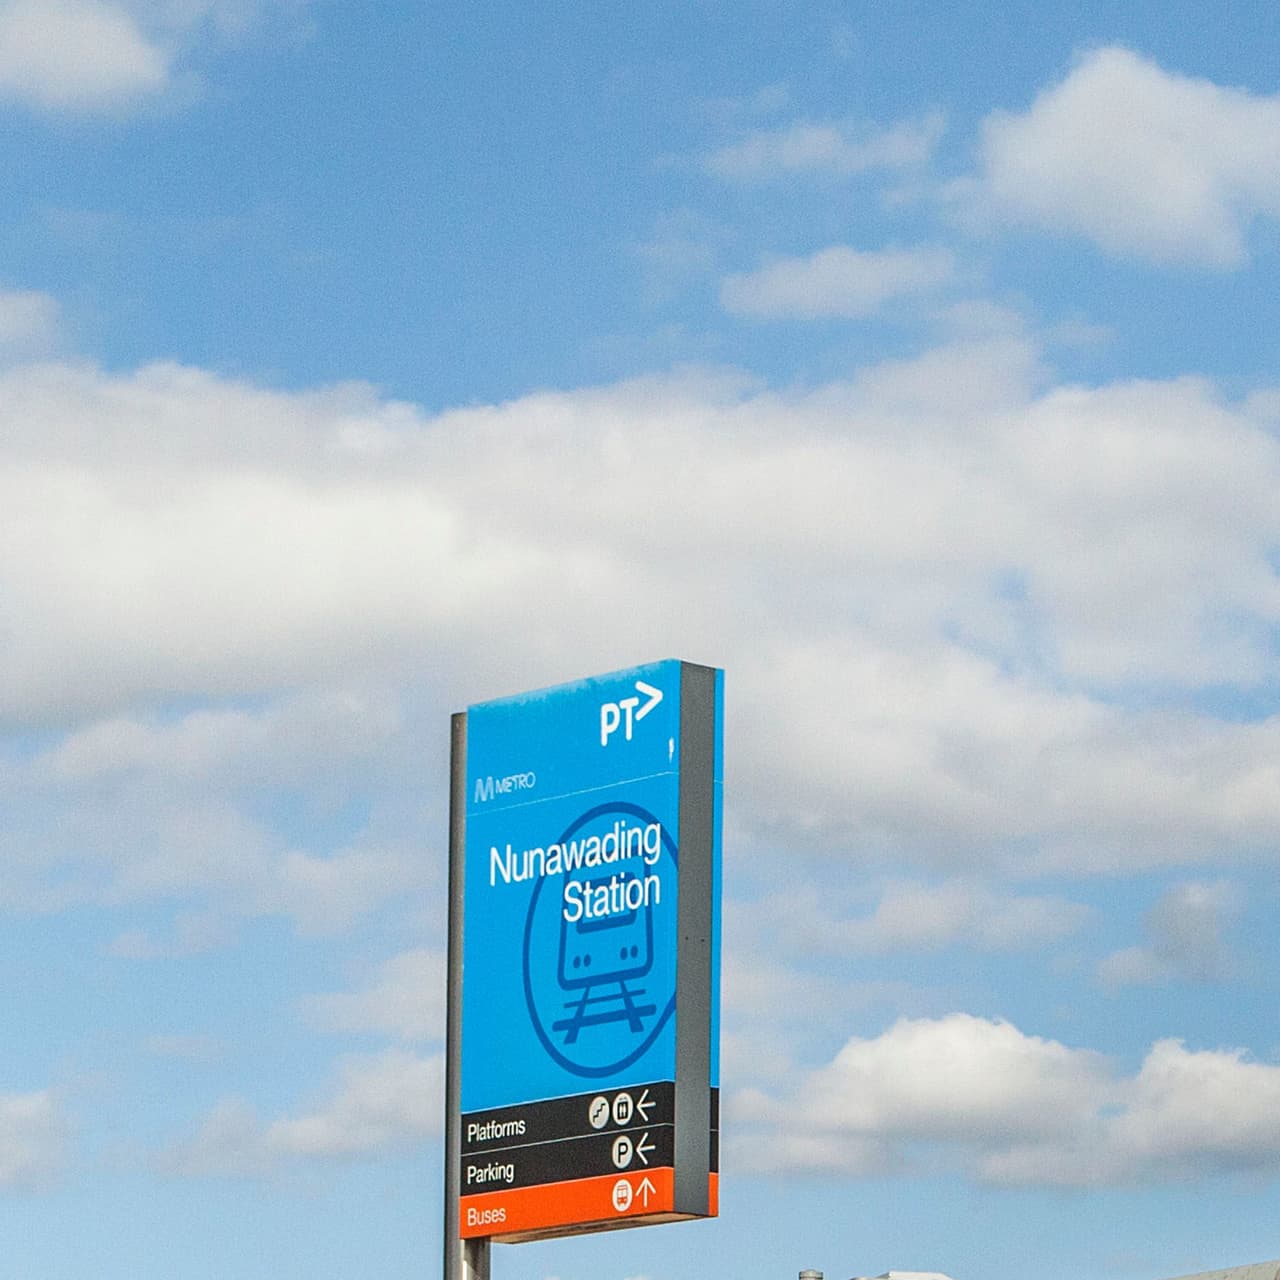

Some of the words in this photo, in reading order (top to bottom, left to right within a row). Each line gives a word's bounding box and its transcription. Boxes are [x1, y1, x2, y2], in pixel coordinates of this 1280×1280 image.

[495, 772, 536, 794] METRO
[490, 822, 661, 886] Nunawading
[563, 873, 661, 922] Station
[467, 1119, 526, 1143] Platforms
[467, 1162, 515, 1184] Parking
[467, 1207, 506, 1227] Buses
